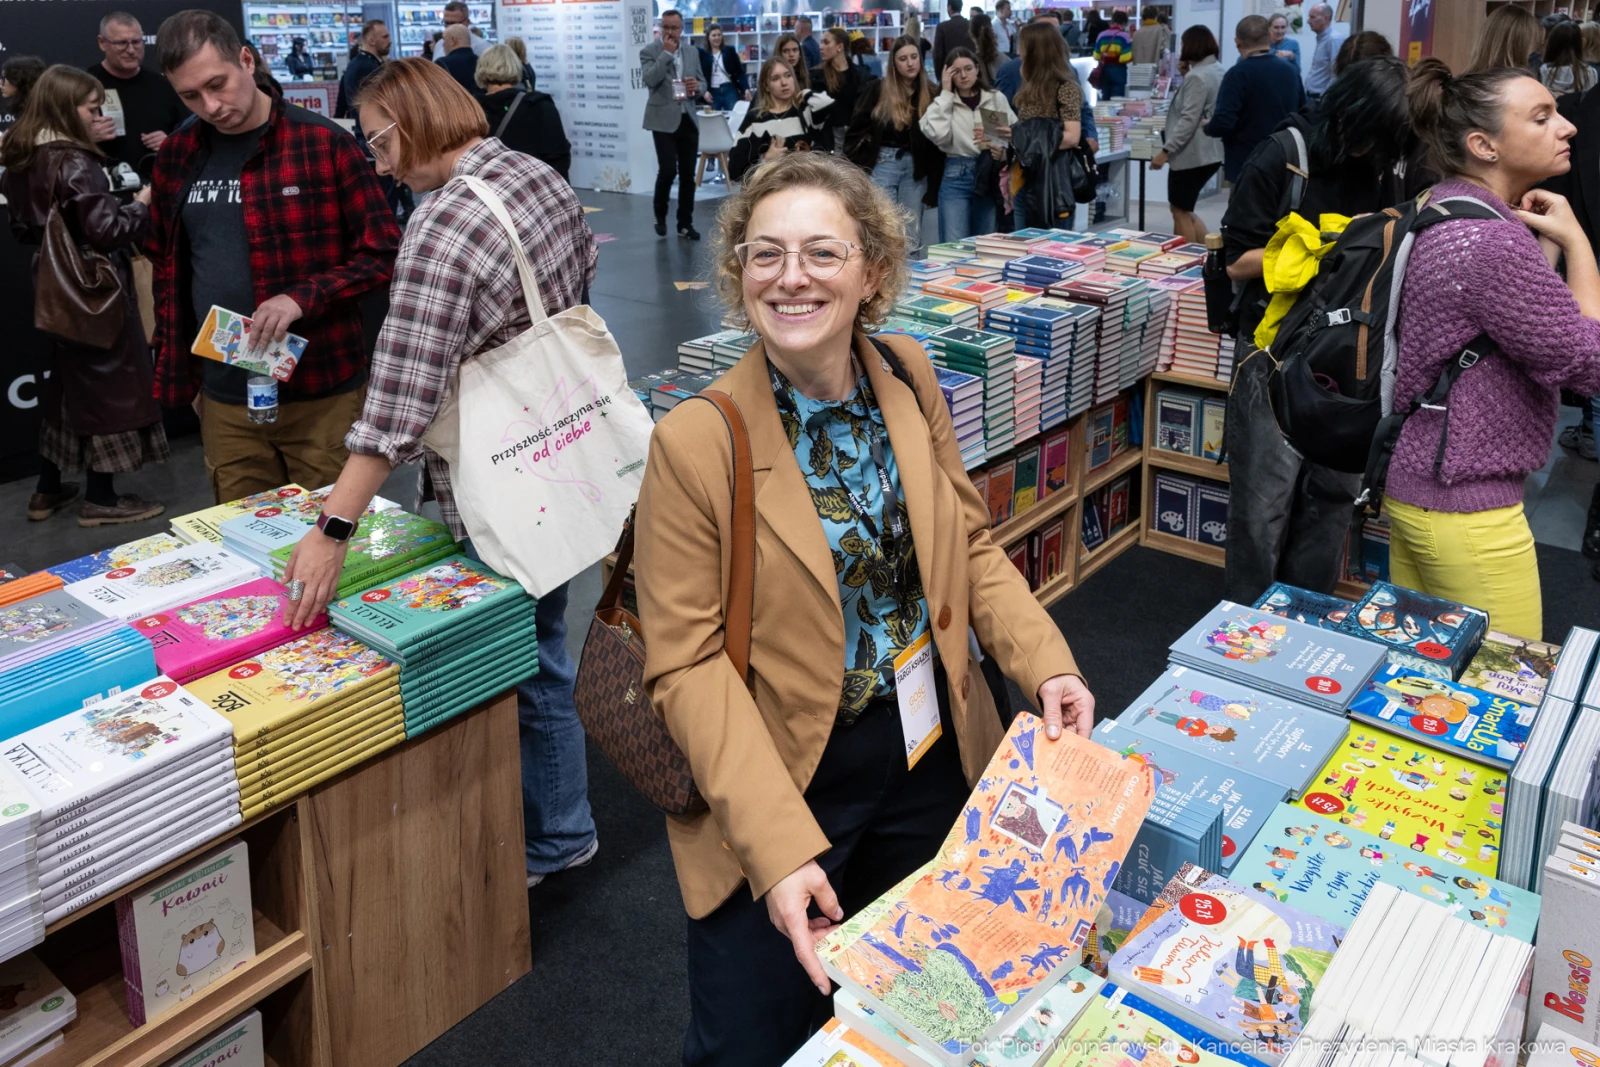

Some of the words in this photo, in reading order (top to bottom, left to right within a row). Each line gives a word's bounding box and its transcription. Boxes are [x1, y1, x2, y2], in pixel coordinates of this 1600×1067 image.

[491, 426, 553, 466] Przyszłość
[553, 403, 594, 432] zaczyna
[595, 394, 612, 409] się
[533, 440, 551, 463] od
[555, 421, 592, 451] ciebie
[211, 693, 245, 712] BÓG
[1467, 698, 1520, 751] SmartUla
[1363, 779, 1448, 814] emocjach
[1366, 796, 1445, 833] Wszystko
[1231, 815, 1248, 829] RAD
[1289, 851, 1325, 894] Wszystko
[162, 873, 228, 917] Kawaii
[1195, 898, 1213, 910] 25
[1194, 909, 1213, 920] zł
[1161, 938, 1200, 970] Tuwim
